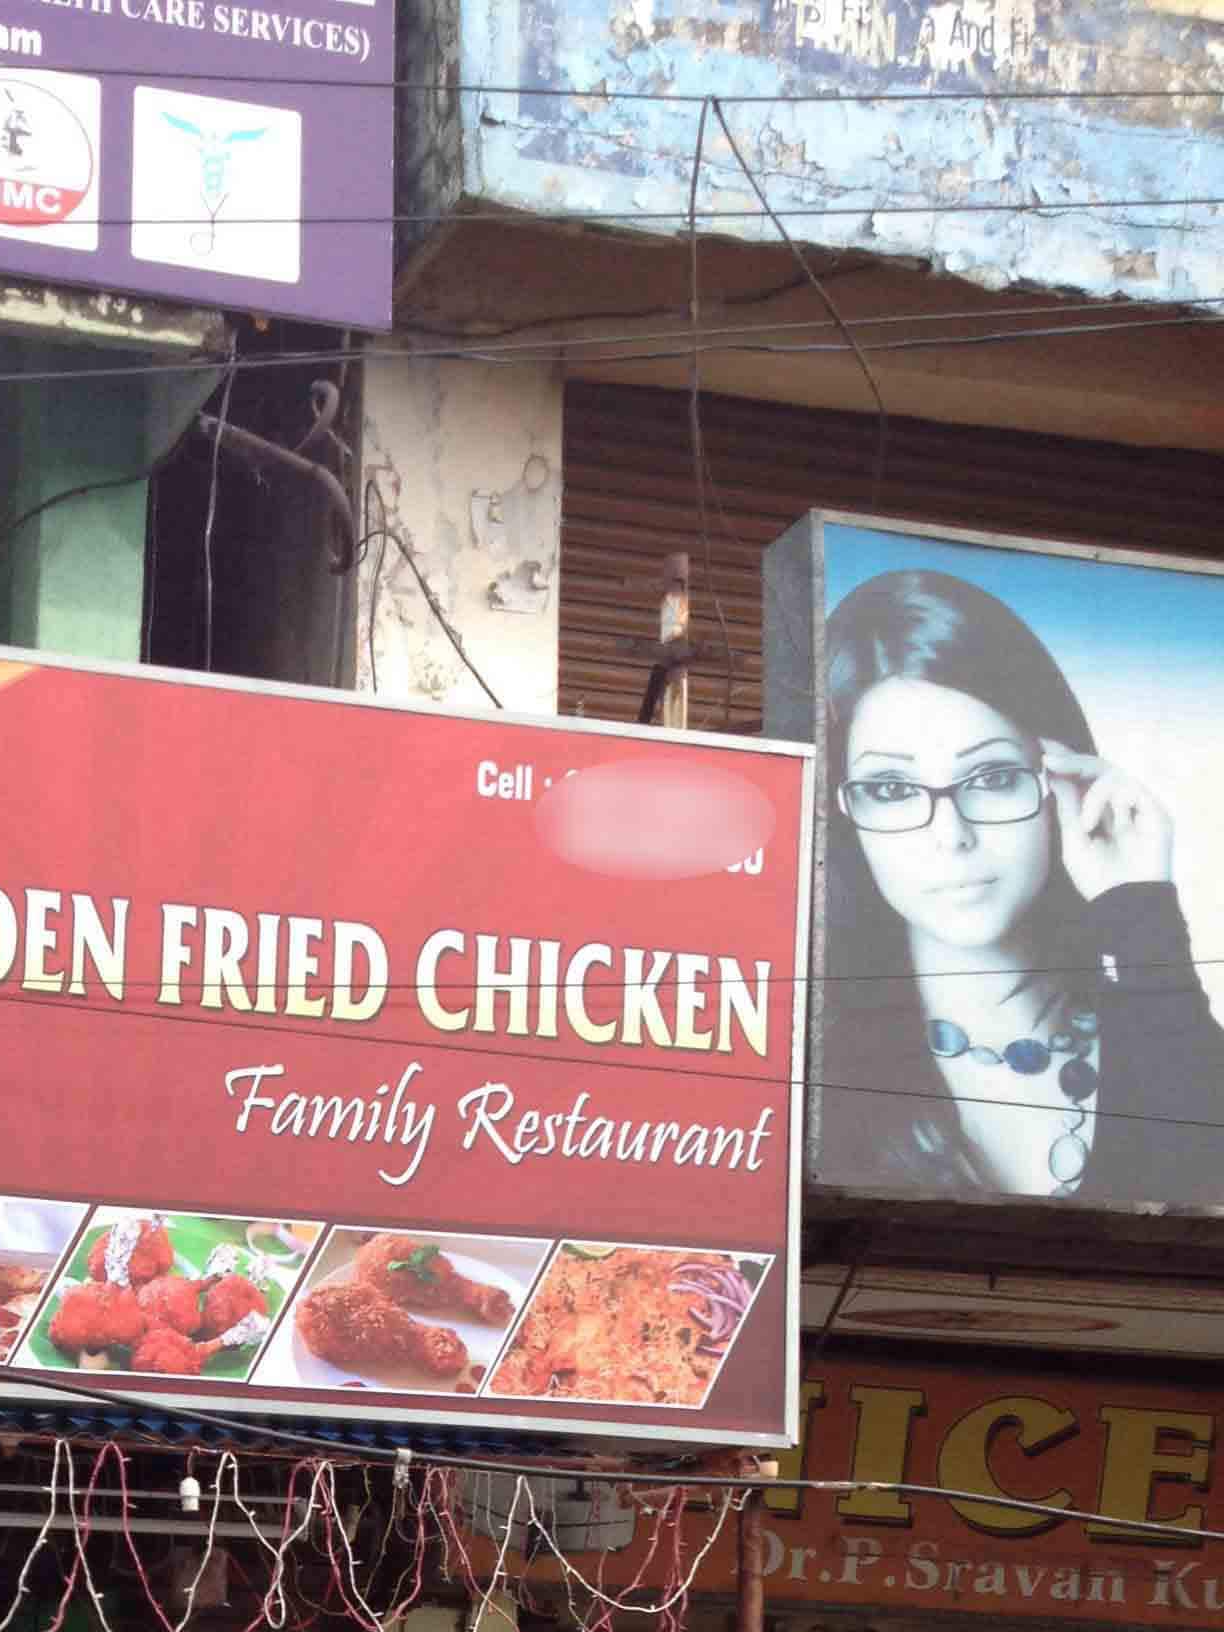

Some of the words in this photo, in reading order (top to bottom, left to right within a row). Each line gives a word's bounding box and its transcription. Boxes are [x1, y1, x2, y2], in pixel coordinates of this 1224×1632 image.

[213, 8, 372, 64] SERVICES)
[477, 760, 533, 800] Cell
[156, 902, 389, 1023] FRIED
[414, 927, 773, 1058] CHICKEN
[224, 1060, 437, 1186] Family
[457, 1081, 774, 1173] Restaurant
